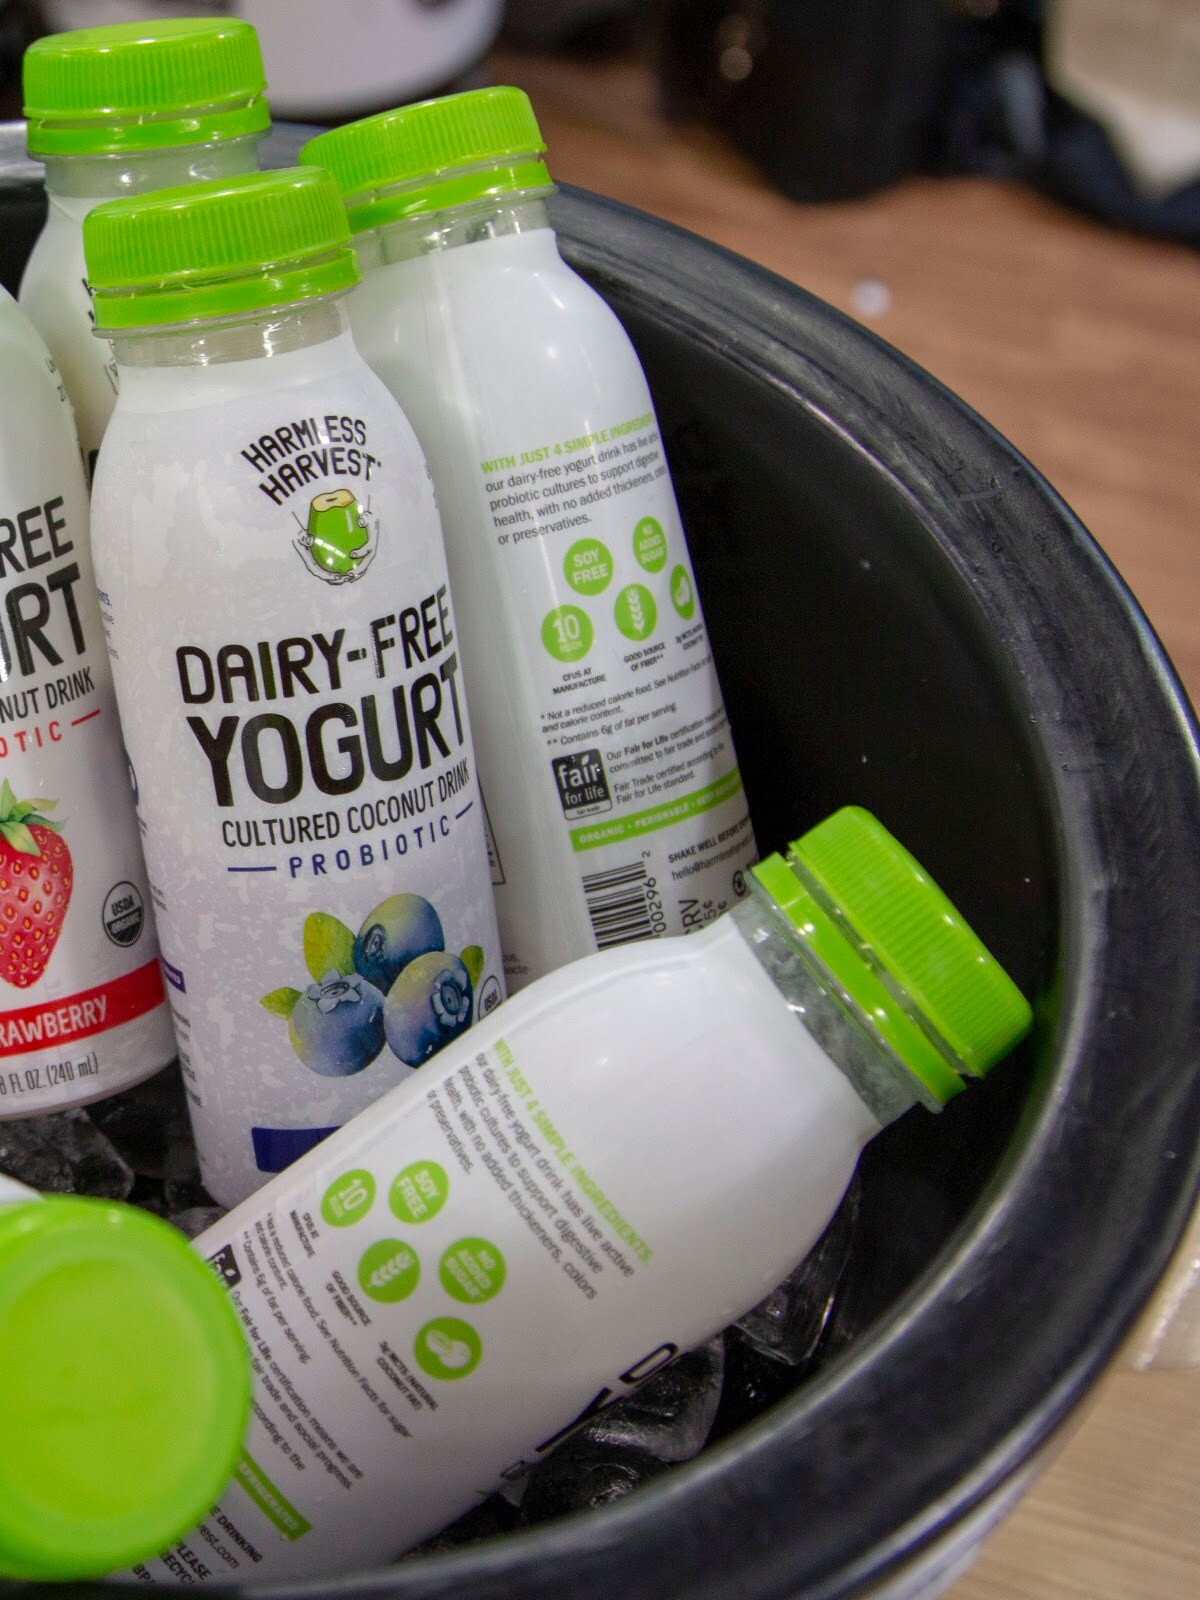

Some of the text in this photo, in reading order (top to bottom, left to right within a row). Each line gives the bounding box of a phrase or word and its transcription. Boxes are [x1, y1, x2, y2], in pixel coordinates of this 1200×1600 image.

[241, 414, 367, 474] HARMLESS
[480, 429, 609, 475] WITH JUST 4 SIMPLE
[259, 447, 377, 506] HARVEST
[485, 440, 637, 493] our dairy-free yogurt drink has
[490, 489, 540, 512] probiotic
[542, 475, 587, 498] cultures
[588, 472, 599, 485] to
[601, 458, 635, 481] support
[494, 486, 612, 528] health, with no added
[498, 513, 592, 546] or preservatives.
[573, 548, 600, 567] SOY
[573, 562, 608, 584] FREE
[175, 584, 453, 705] DAIRY-FREE
[552, 614, 581, 643] 10
[624, 650, 643, 663] GOOD
[631, 662, 639, 672] OF
[45, 666, 95, 709] DRINK
[552, 674, 607, 695] MANUFACTURE
[563, 667, 592, 682] CFUS AT
[542, 705, 624, 733] and calorie content.
[547, 708, 564, 721] Not
[565, 709, 571, 718] a
[572, 699, 607, 715] reduced
[608, 689, 634, 705] calorie
[186, 651, 465, 807] YOGURT
[561, 712, 650, 745] Contains 6g of fat per
[607, 734, 669, 761] Our Fair for Life
[610, 752, 654, 774] committed
[656, 748, 663, 759] to
[665, 743, 676, 755] fair
[558, 760, 599, 790] fair
[614, 763, 685, 793] Fair Trade certified
[222, 757, 470, 848] CULTURED COCONUT DRINK
[565, 786, 604, 806] for life
[617, 784, 662, 804] Fair for Life
[289, 814, 450, 878] PROBIOTIC
[668, 838, 717, 863] SHAKE WELL
[110, 912, 143, 934] ORGANIC
[111, 895, 134, 917] USDA
[9, 1072, 23, 1092] FL
[24, 1068, 46, 1090] OZ.
[45, 1059, 75, 1085] (240
[78, 1051, 100, 1077] mL)
[508, 1067, 533, 1101] JUST
[532, 1110, 575, 1166] SIMPLE
[412, 1168, 441, 1201] SOY
[482, 1065, 635, 1277] dairy-free yogurt drink has live active
[335, 1176, 371, 1212] 10
[394, 1176, 430, 1219] FREE
[457, 1109, 477, 1134] with
[471, 1134, 487, 1152] no
[481, 1151, 513, 1190] added
[561, 1261, 599, 1300] colors
[478, 1106, 512, 1154] cultures
[506, 1152, 523, 1169] to
[515, 1167, 558, 1219] support
[553, 1217, 604, 1273] digestive
[238, 1306, 254, 1328] Fair
[248, 1325, 263, 1342] for
[256, 1339, 275, 1362] Life
[268, 1359, 313, 1419] certification
[307, 1416, 338, 1450] means
[327, 1336, 361, 1379] Nutrition
[356, 1375, 380, 1403] Facts
[375, 1399, 392, 1417] for
[259, 1373, 320, 1452] trade and social
[288, 1452, 306, 1472] the
[215, 1514, 263, 1563] DRINKING
